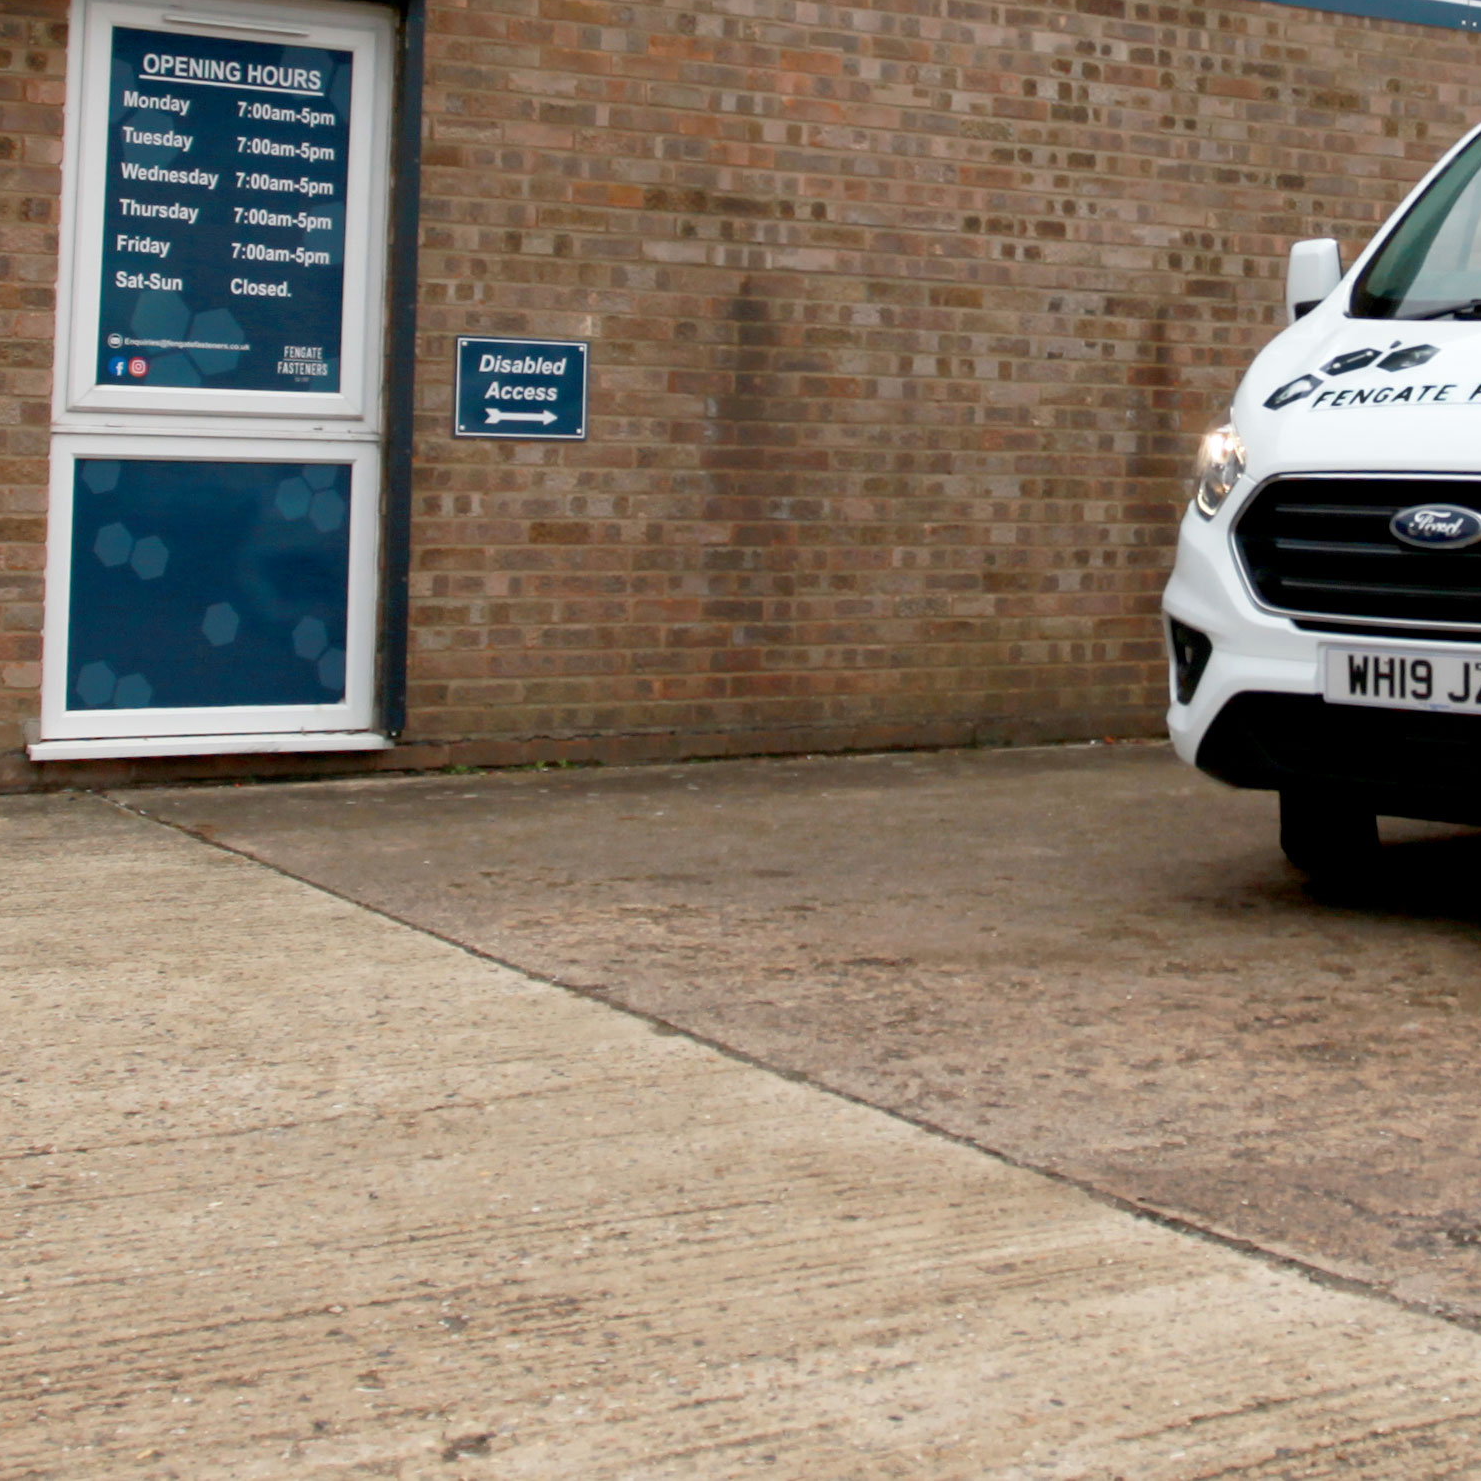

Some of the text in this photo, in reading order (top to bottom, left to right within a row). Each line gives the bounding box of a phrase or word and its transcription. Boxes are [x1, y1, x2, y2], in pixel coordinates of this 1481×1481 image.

[143, 53, 322, 90] OPENING HOURS
[123, 91, 335, 127] Monday 7:00am-5pm
[122, 126, 335, 162] Tuesday 7:00am-5pm
[121, 163, 334, 197] Wednesday 7:00am-5pm
[119, 199, 332, 231] Thursday 7:00am-5pm
[117, 235, 330, 267] Friday 7:00am-5pm
[115, 271, 183, 292] Sat-Sun
[284, 346, 322, 359] FENGATE
[479, 354, 567, 375] Disabled
[277, 361, 328, 376] FASTENERS
[484, 381, 558, 401] Access
[1312, 384, 1455, 408] FENGATE
[1409, 510, 1464, 534] Ford
[1347, 655, 1433, 700] WH19
